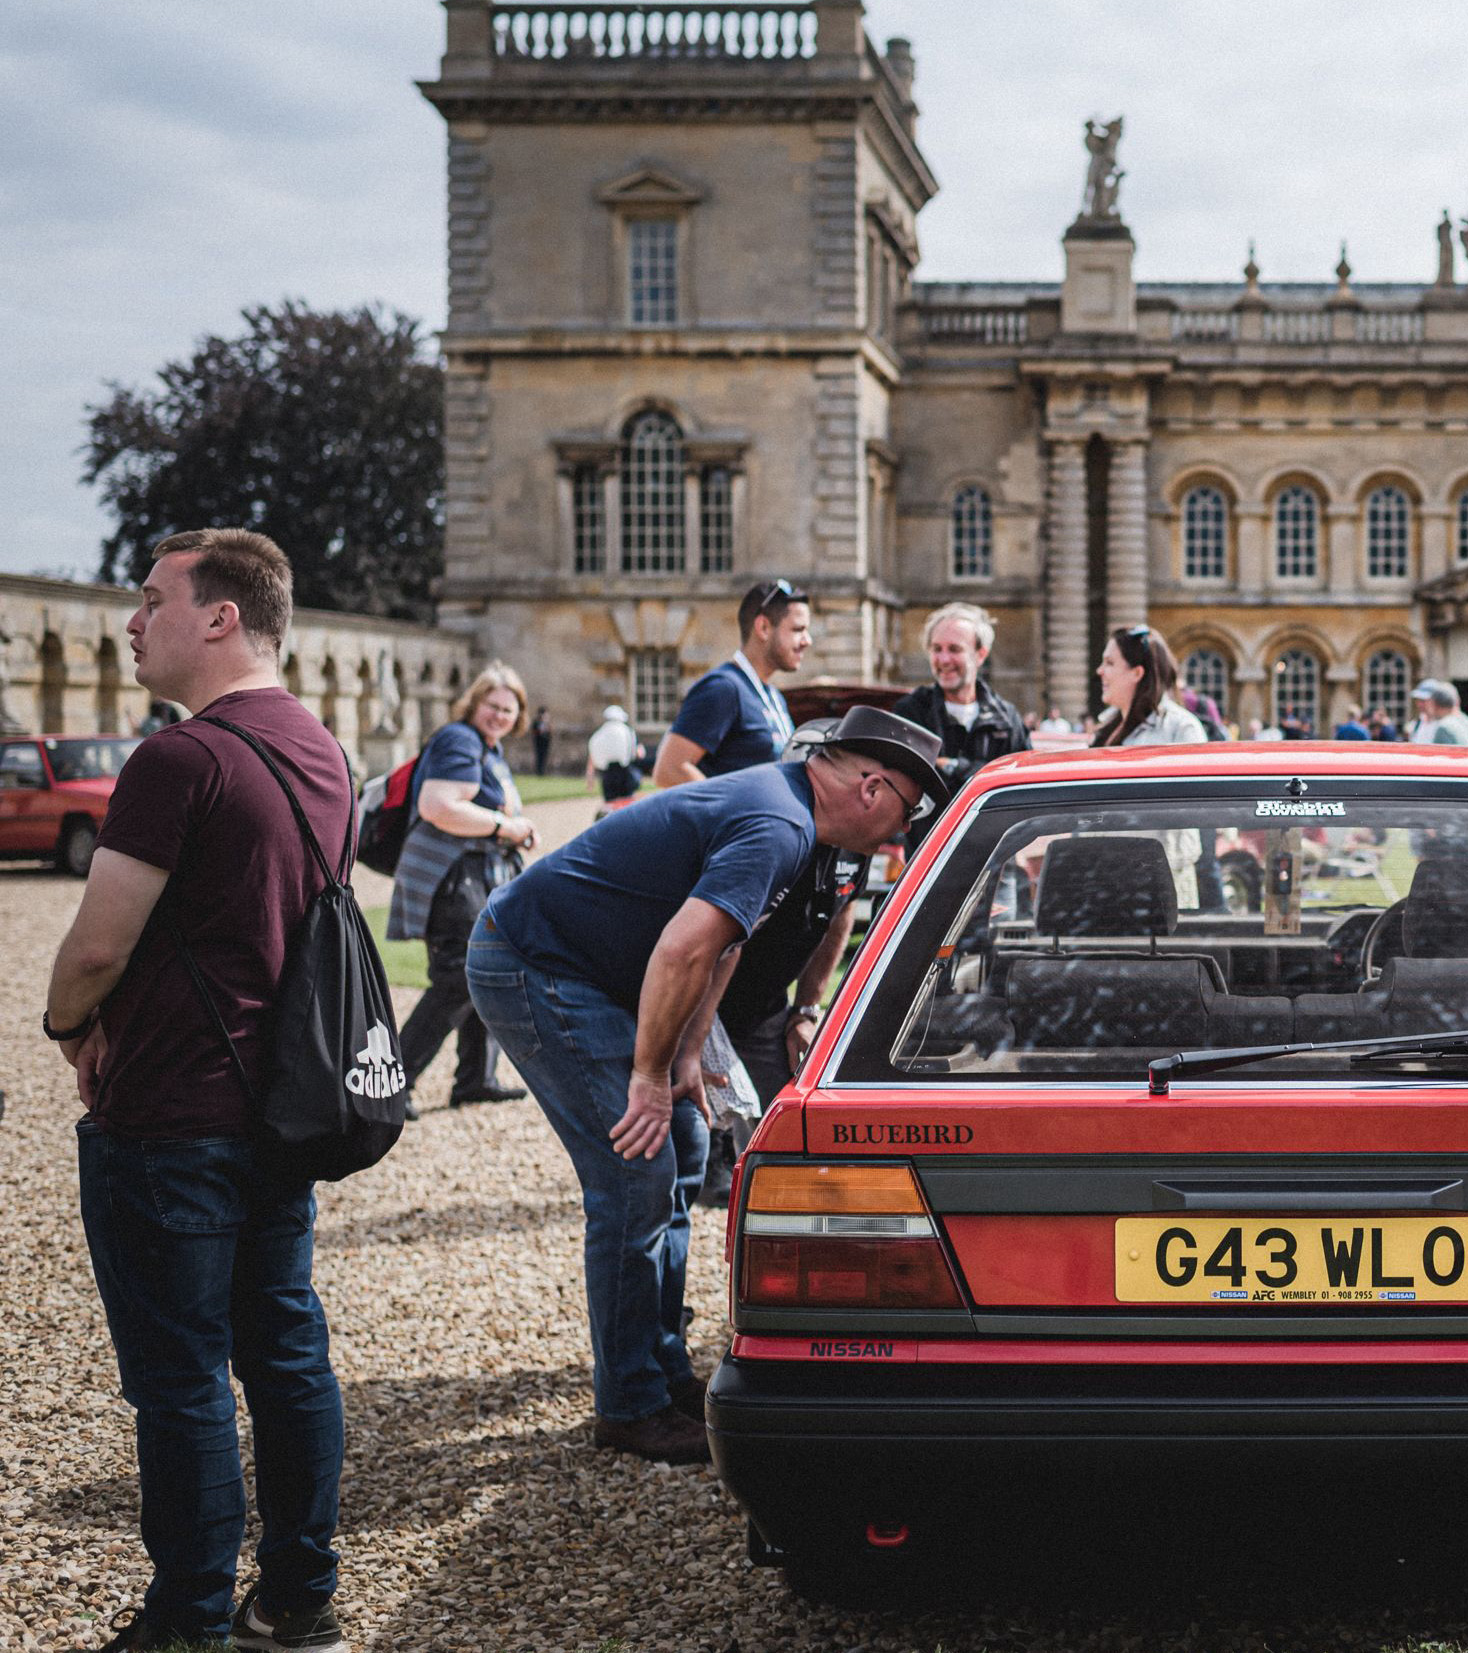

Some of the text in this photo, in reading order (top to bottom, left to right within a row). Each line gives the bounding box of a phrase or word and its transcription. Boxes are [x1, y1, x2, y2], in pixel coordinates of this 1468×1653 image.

[1257, 802, 1344, 811] Bluebird
[345, 1063, 406, 1099] adidas
[832, 1124, 974, 1144] BLUEBIRD
[1155, 1225, 1466, 1288] G43 WLO
[1220, 1291, 1247, 1299] NISSAN
[1281, 1291, 1317, 1299] WEMBLEY
[1321, 1291, 1330, 1299] 01
[1338, 1291, 1352, 1299] 908
[1354, 1291, 1373, 1299] 2955
[810, 1342, 894, 1357] NISSAN
